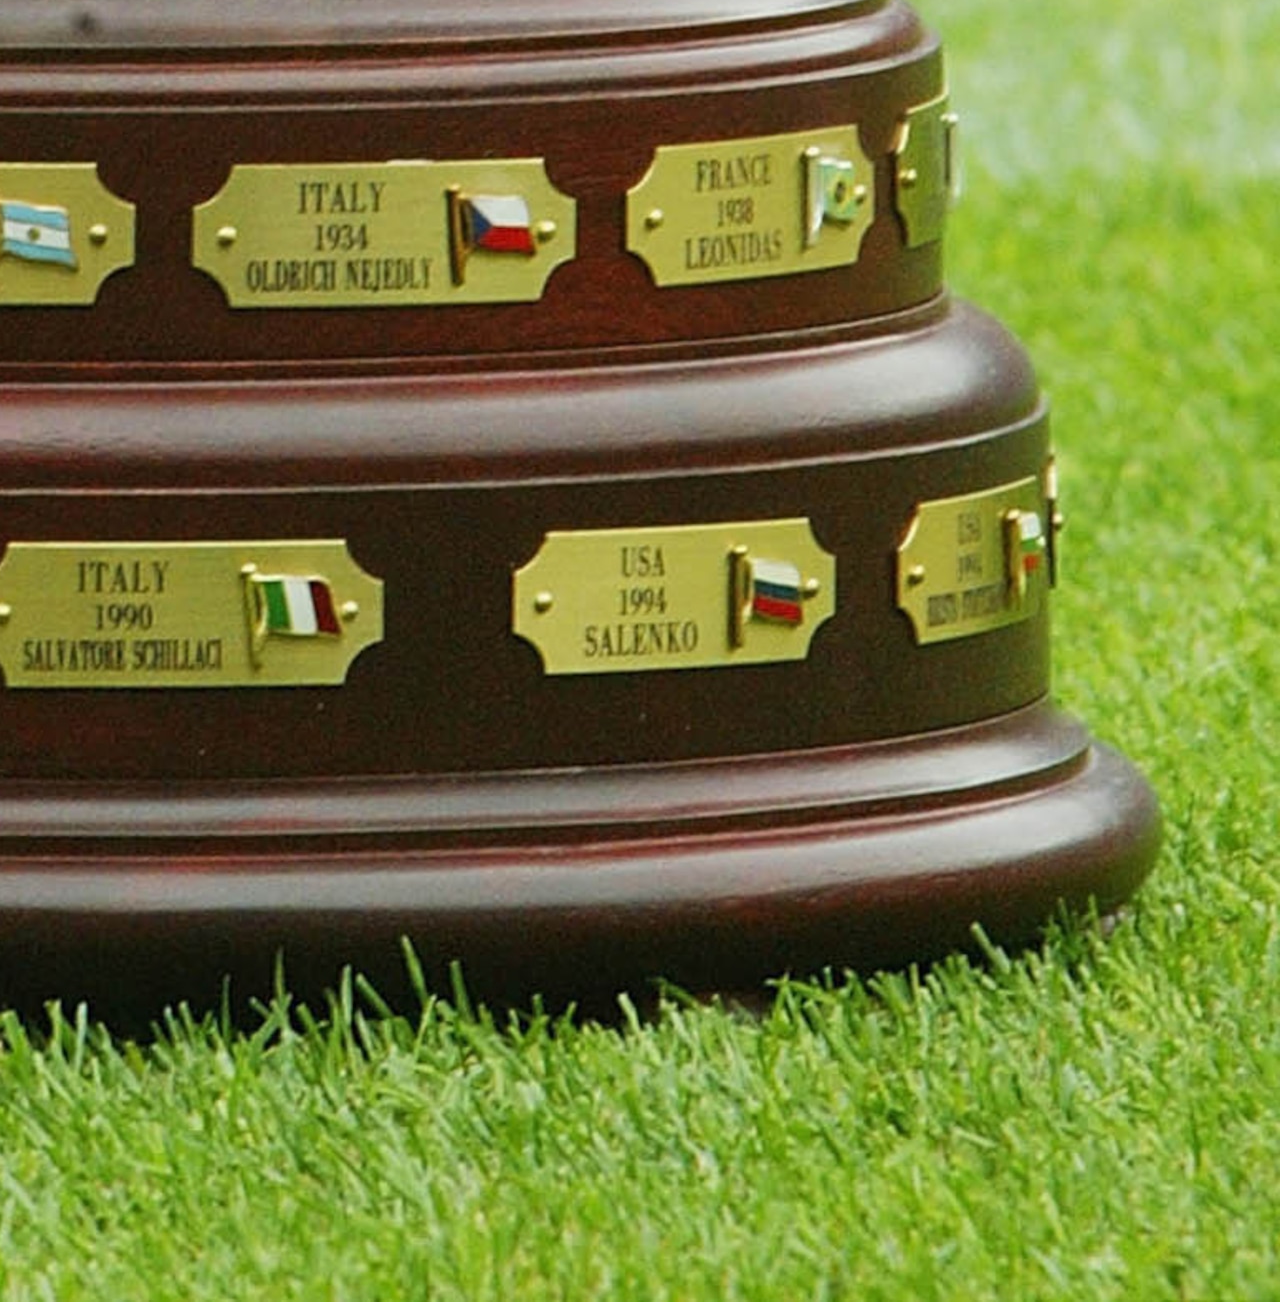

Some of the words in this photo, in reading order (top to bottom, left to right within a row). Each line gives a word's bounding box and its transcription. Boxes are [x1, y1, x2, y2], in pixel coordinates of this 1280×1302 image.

[696, 154, 772, 193] FRANCE
[297, 181, 386, 214] ITALY
[315, 223, 369, 251] 1934
[685, 229, 782, 270] LEONIDAS
[246, 258, 337, 293] OLDRICH
[344, 256, 433, 292] NEJEDLY
[76, 560, 169, 593] ITALY
[621, 545, 666, 577] USA
[96, 603, 153, 631] 1990
[619, 587, 667, 616] 1994
[23, 638, 126, 672] SALVATORE
[584, 620, 699, 658] SALENKO
